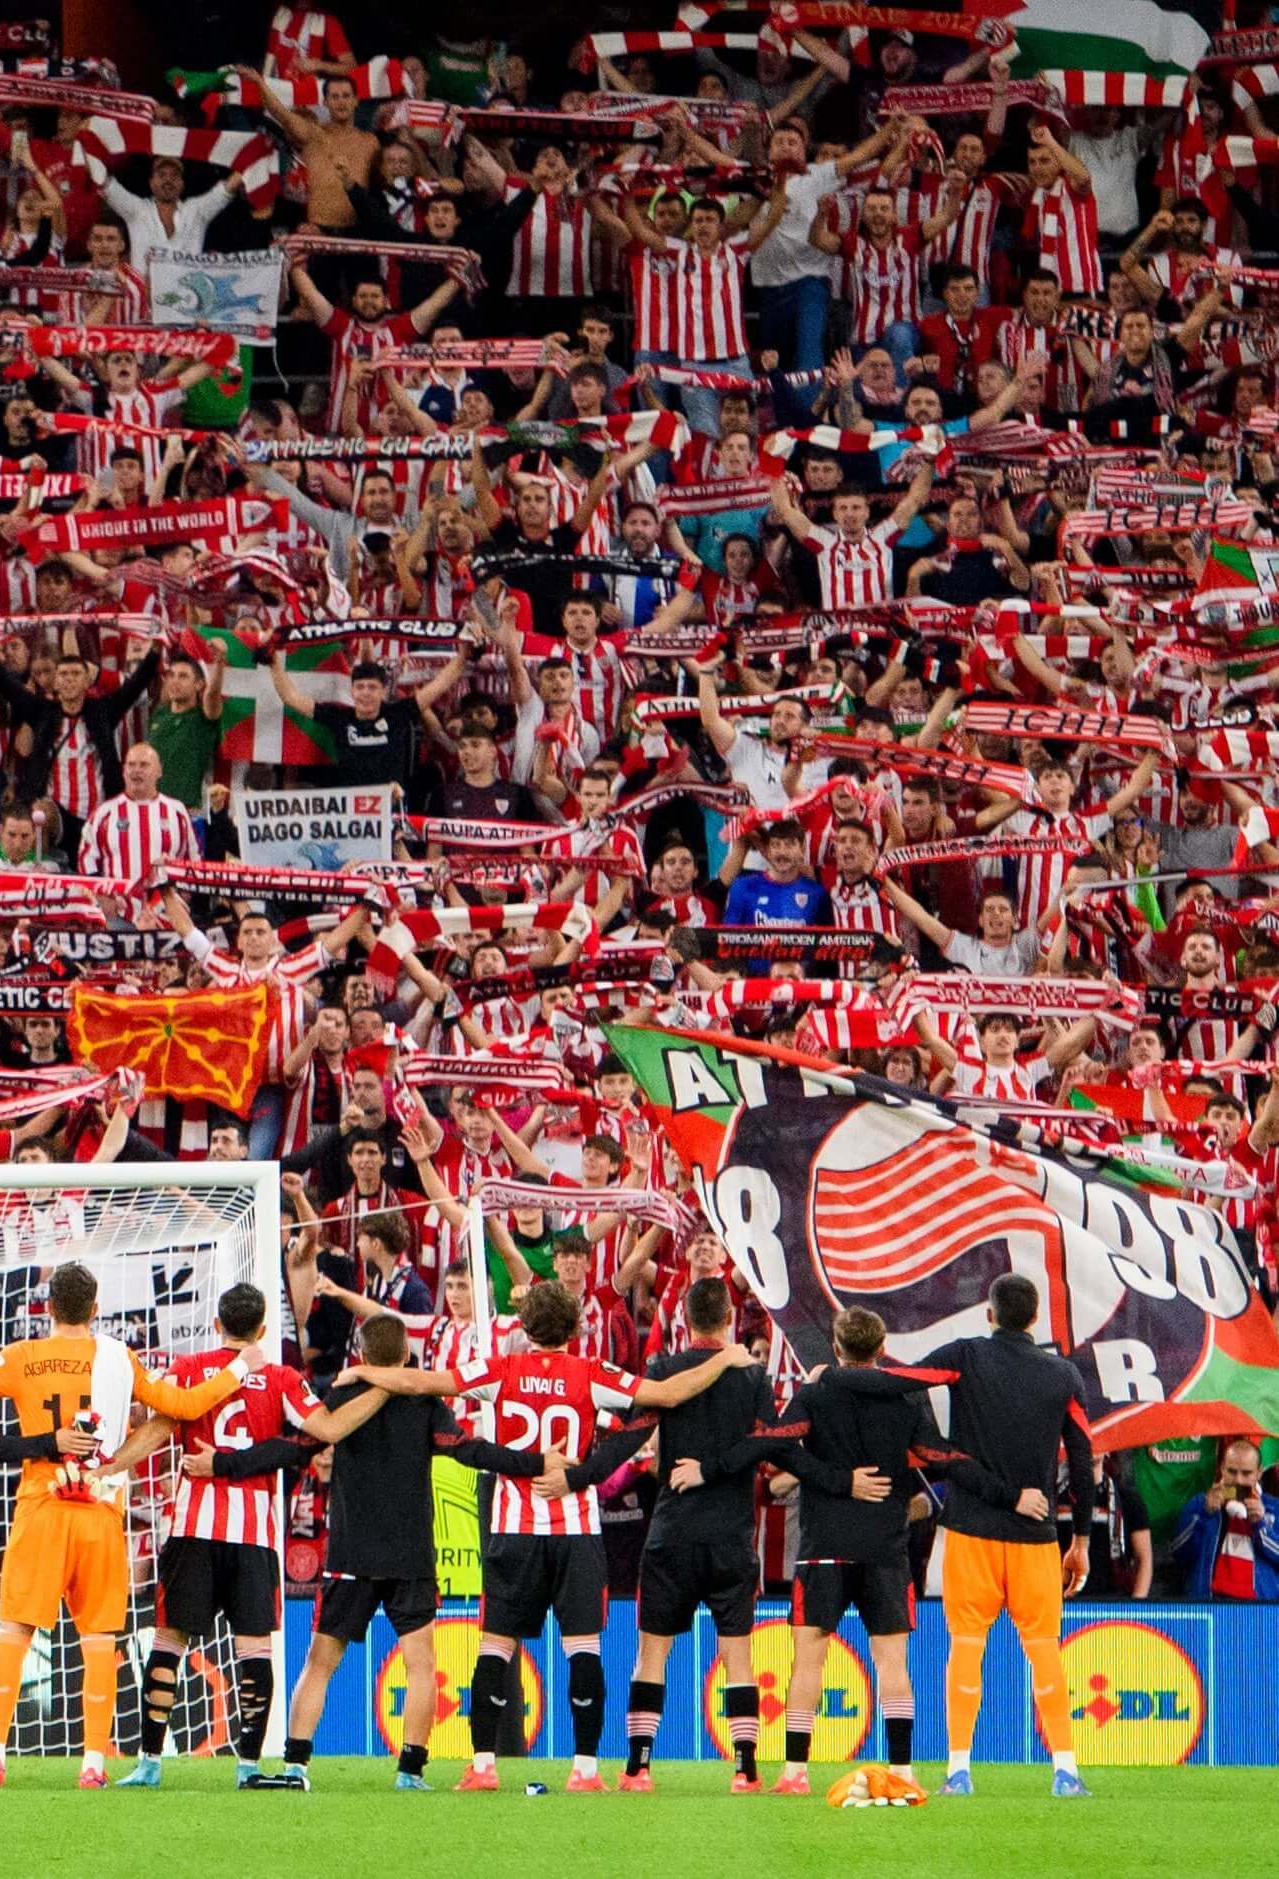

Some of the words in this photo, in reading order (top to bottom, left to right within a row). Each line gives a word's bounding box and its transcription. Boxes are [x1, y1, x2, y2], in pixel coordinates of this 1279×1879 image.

[80, 521, 131, 540] UNIQUE
[133, 519, 149, 536] IN
[150, 516, 175, 533] THE
[177, 510, 225, 530] WORLD
[288, 619, 392, 641] ATHLETIC
[397, 619, 458, 639] CLUB
[1005, 709, 1125, 738] ICHH
[244, 797, 348, 819] URDAIBAI
[355, 796, 382, 815] EZ
[248, 822, 304, 844] DAGO
[309, 819, 383, 840] SALGAI
[1191, 991, 1255, 1012] CLUB
[519, 1375, 553, 1395] UNAI
[500, 1400, 581, 1460] 20
